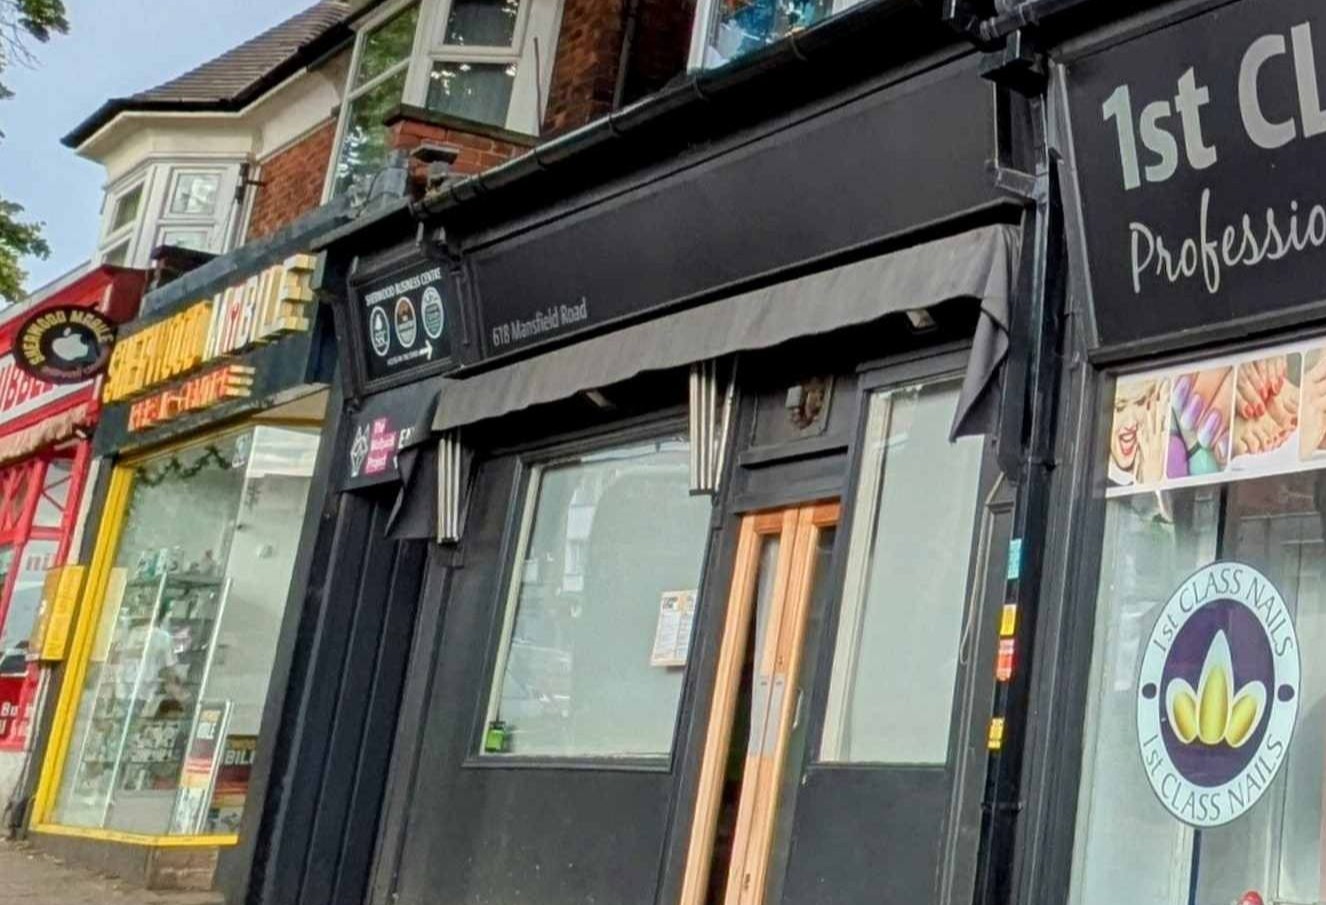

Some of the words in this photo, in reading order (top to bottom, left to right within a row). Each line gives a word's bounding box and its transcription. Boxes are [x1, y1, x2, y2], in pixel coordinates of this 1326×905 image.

[1102, 67, 1217, 191] 1st
[510, 306, 559, 340] Mansfield
[560, 296, 588, 325] Road
[1178, 567, 1244, 615] CLASS
[1245, 576, 1294, 658] NAILS
[1160, 772, 1222, 822] CLASS
[1226, 732, 1285, 815] NAILS
